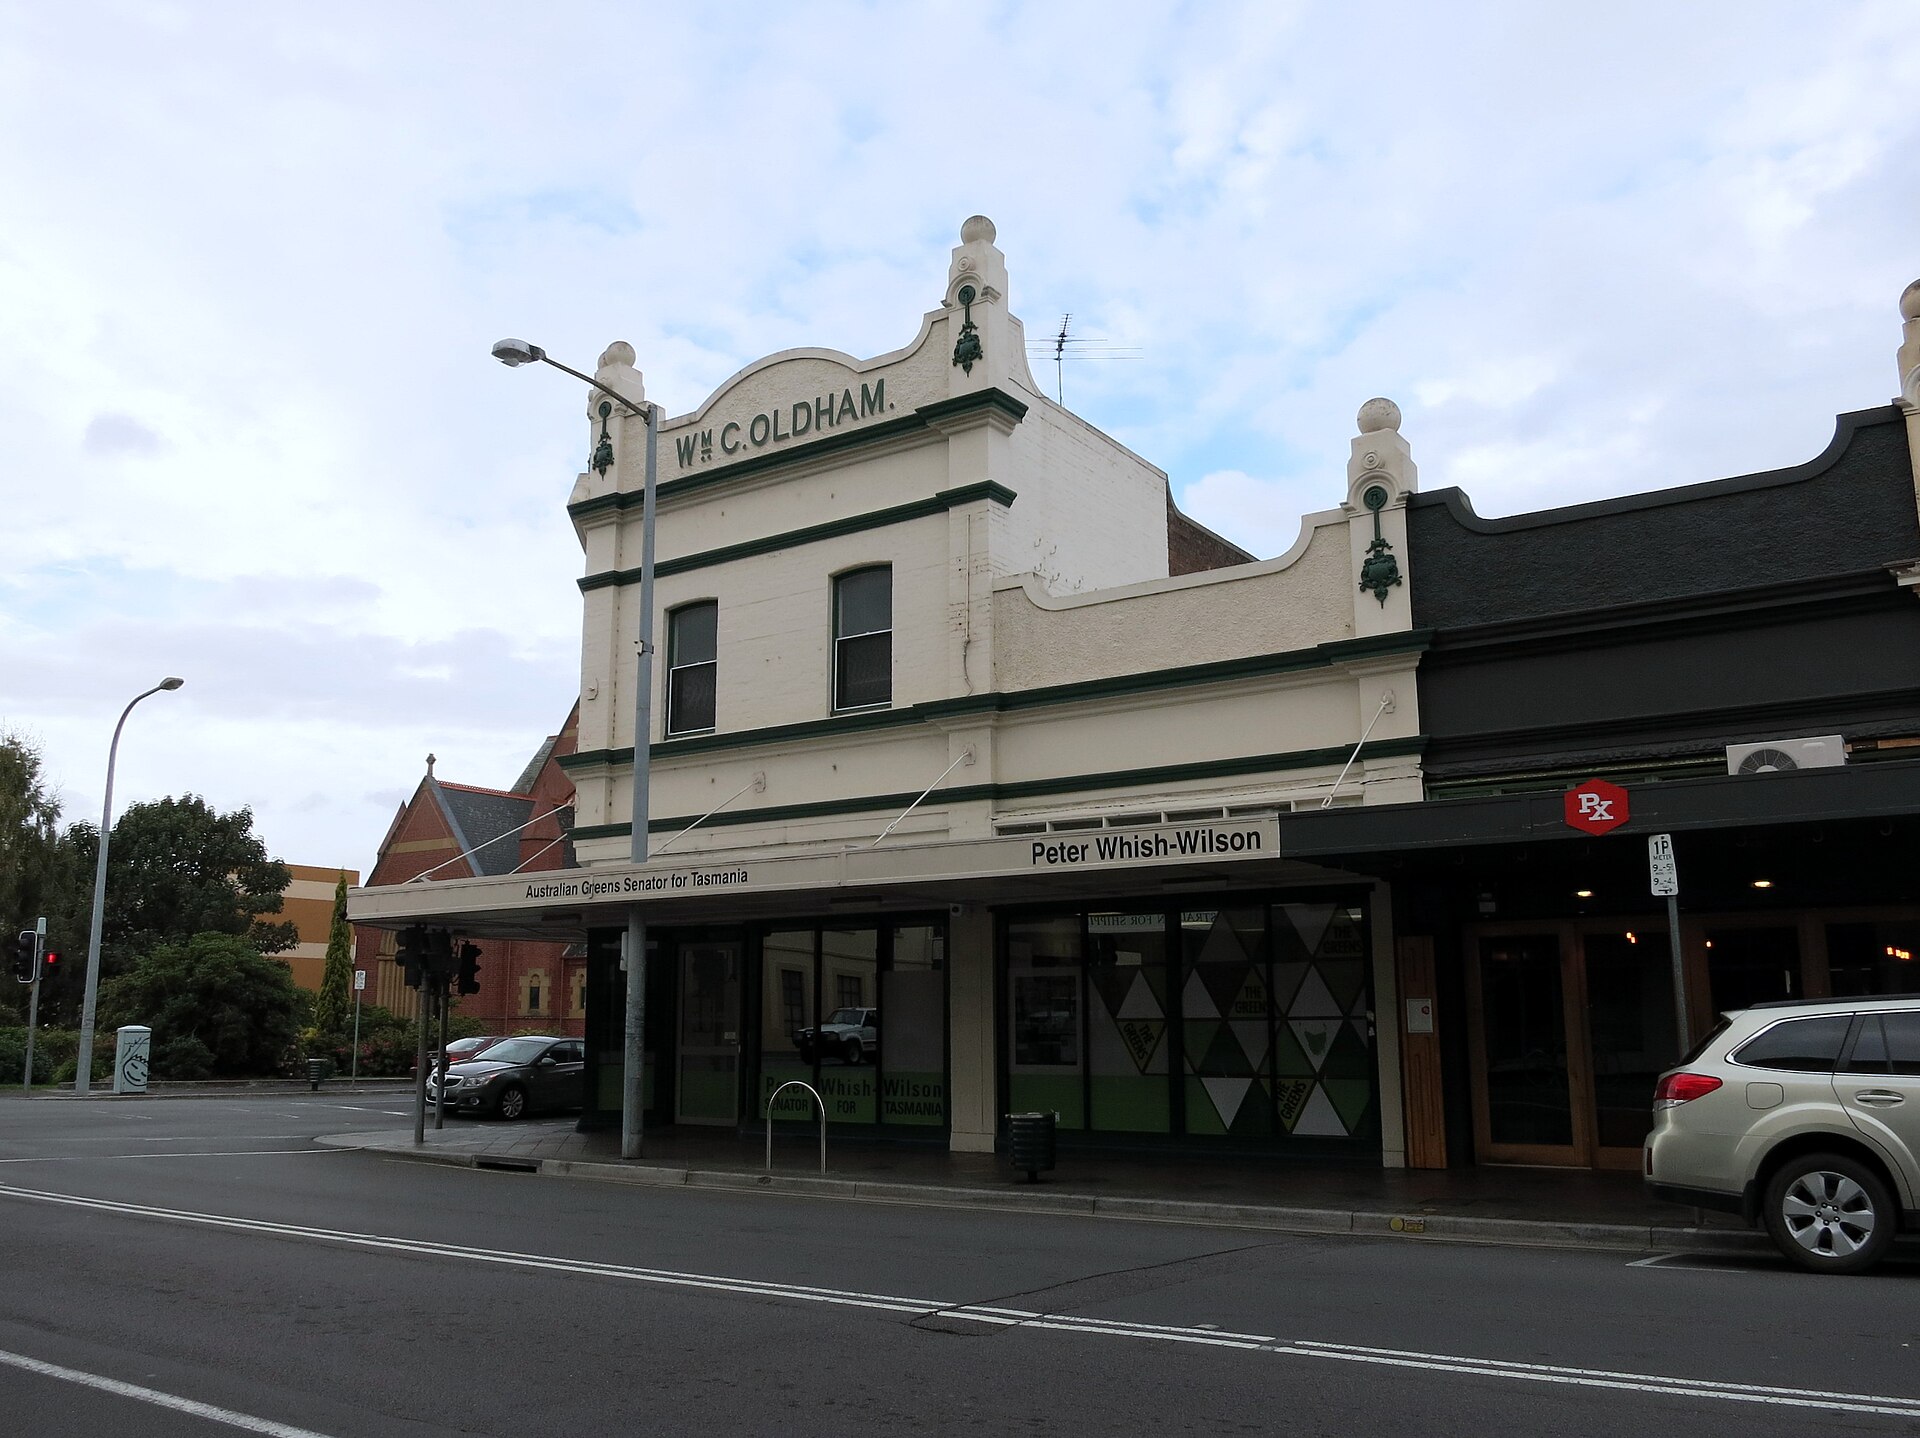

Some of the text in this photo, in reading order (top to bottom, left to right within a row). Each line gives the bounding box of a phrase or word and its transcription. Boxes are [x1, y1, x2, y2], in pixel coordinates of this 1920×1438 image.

[1031, 829, 1262, 865] Peter Whish-Wilson
[1653, 840, 1669, 855] 1P
[525, 868, 748, 899] Australian Greens Senator for Tasmania
[1244, 986, 1262, 999] THE
[1123, 1023, 1149, 1060] GREENS
[1139, 1024, 1156, 1044] THE
[883, 1079, 942, 1098] Wilson
[837, 1100, 857, 1114] FOR
[884, 1101, 943, 1117] TASMANIA
[1280, 1080, 1307, 1120] GREENS
